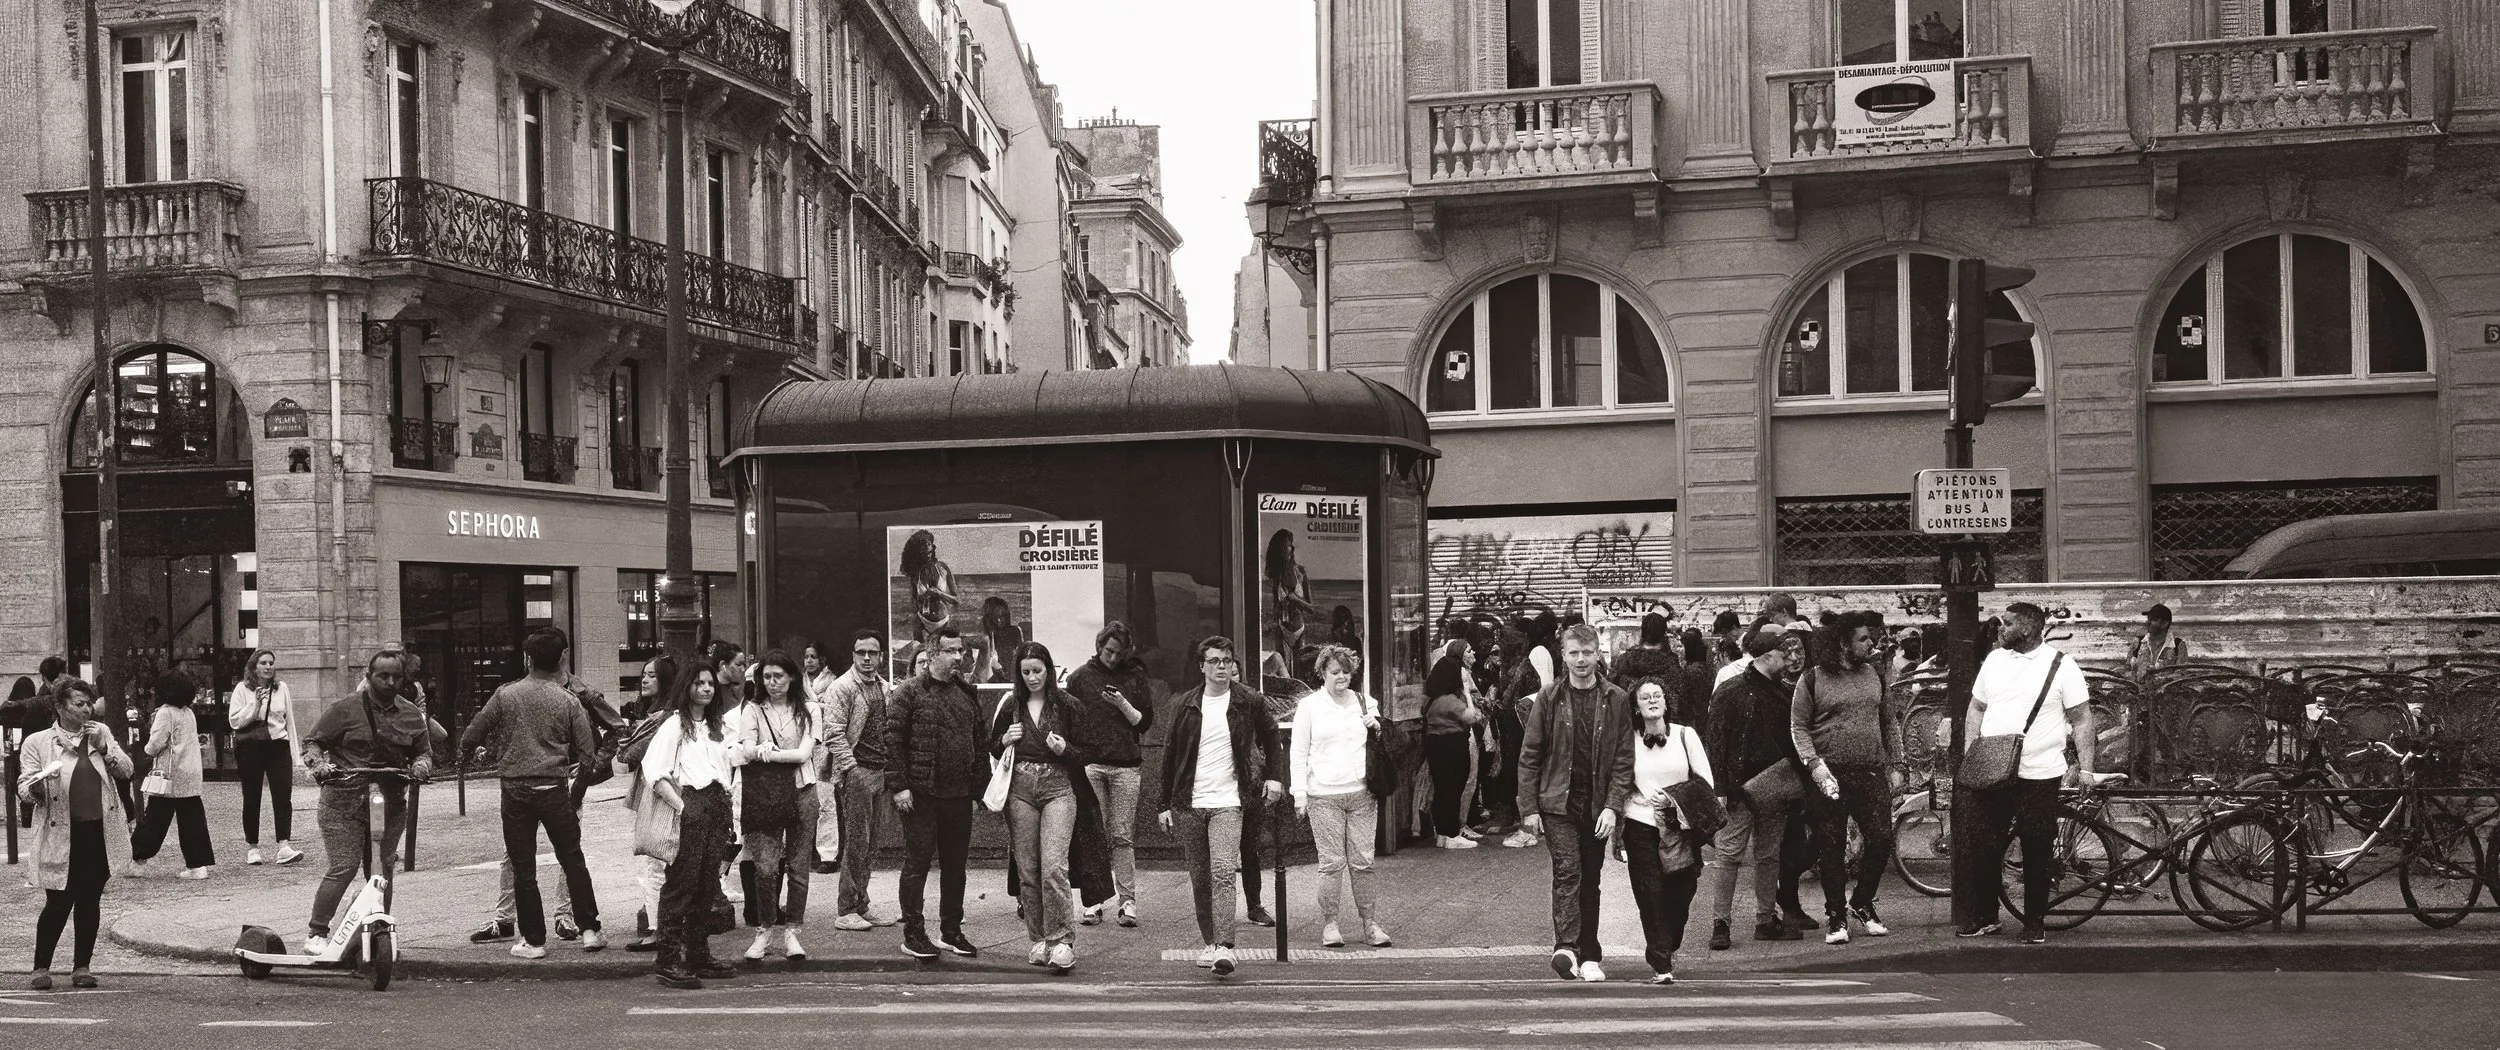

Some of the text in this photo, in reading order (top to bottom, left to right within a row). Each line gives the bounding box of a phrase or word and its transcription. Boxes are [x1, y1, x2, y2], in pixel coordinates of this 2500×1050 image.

[1935, 475, 1997, 487] PIÉTONS
[1927, 488, 2004, 500] ATTENTION
[1260, 494, 1360, 520] Etam DÉFILÉ
[1945, 501, 1989, 515] BUS À
[448, 510, 540, 539] SEPHORA
[1927, 517, 2008, 529] CONTRESENS
[1018, 523, 1098, 548] DÉFILÉ
[1019, 547, 1099, 563] CROISIÈRE
[333, 911, 360, 946] Lime
